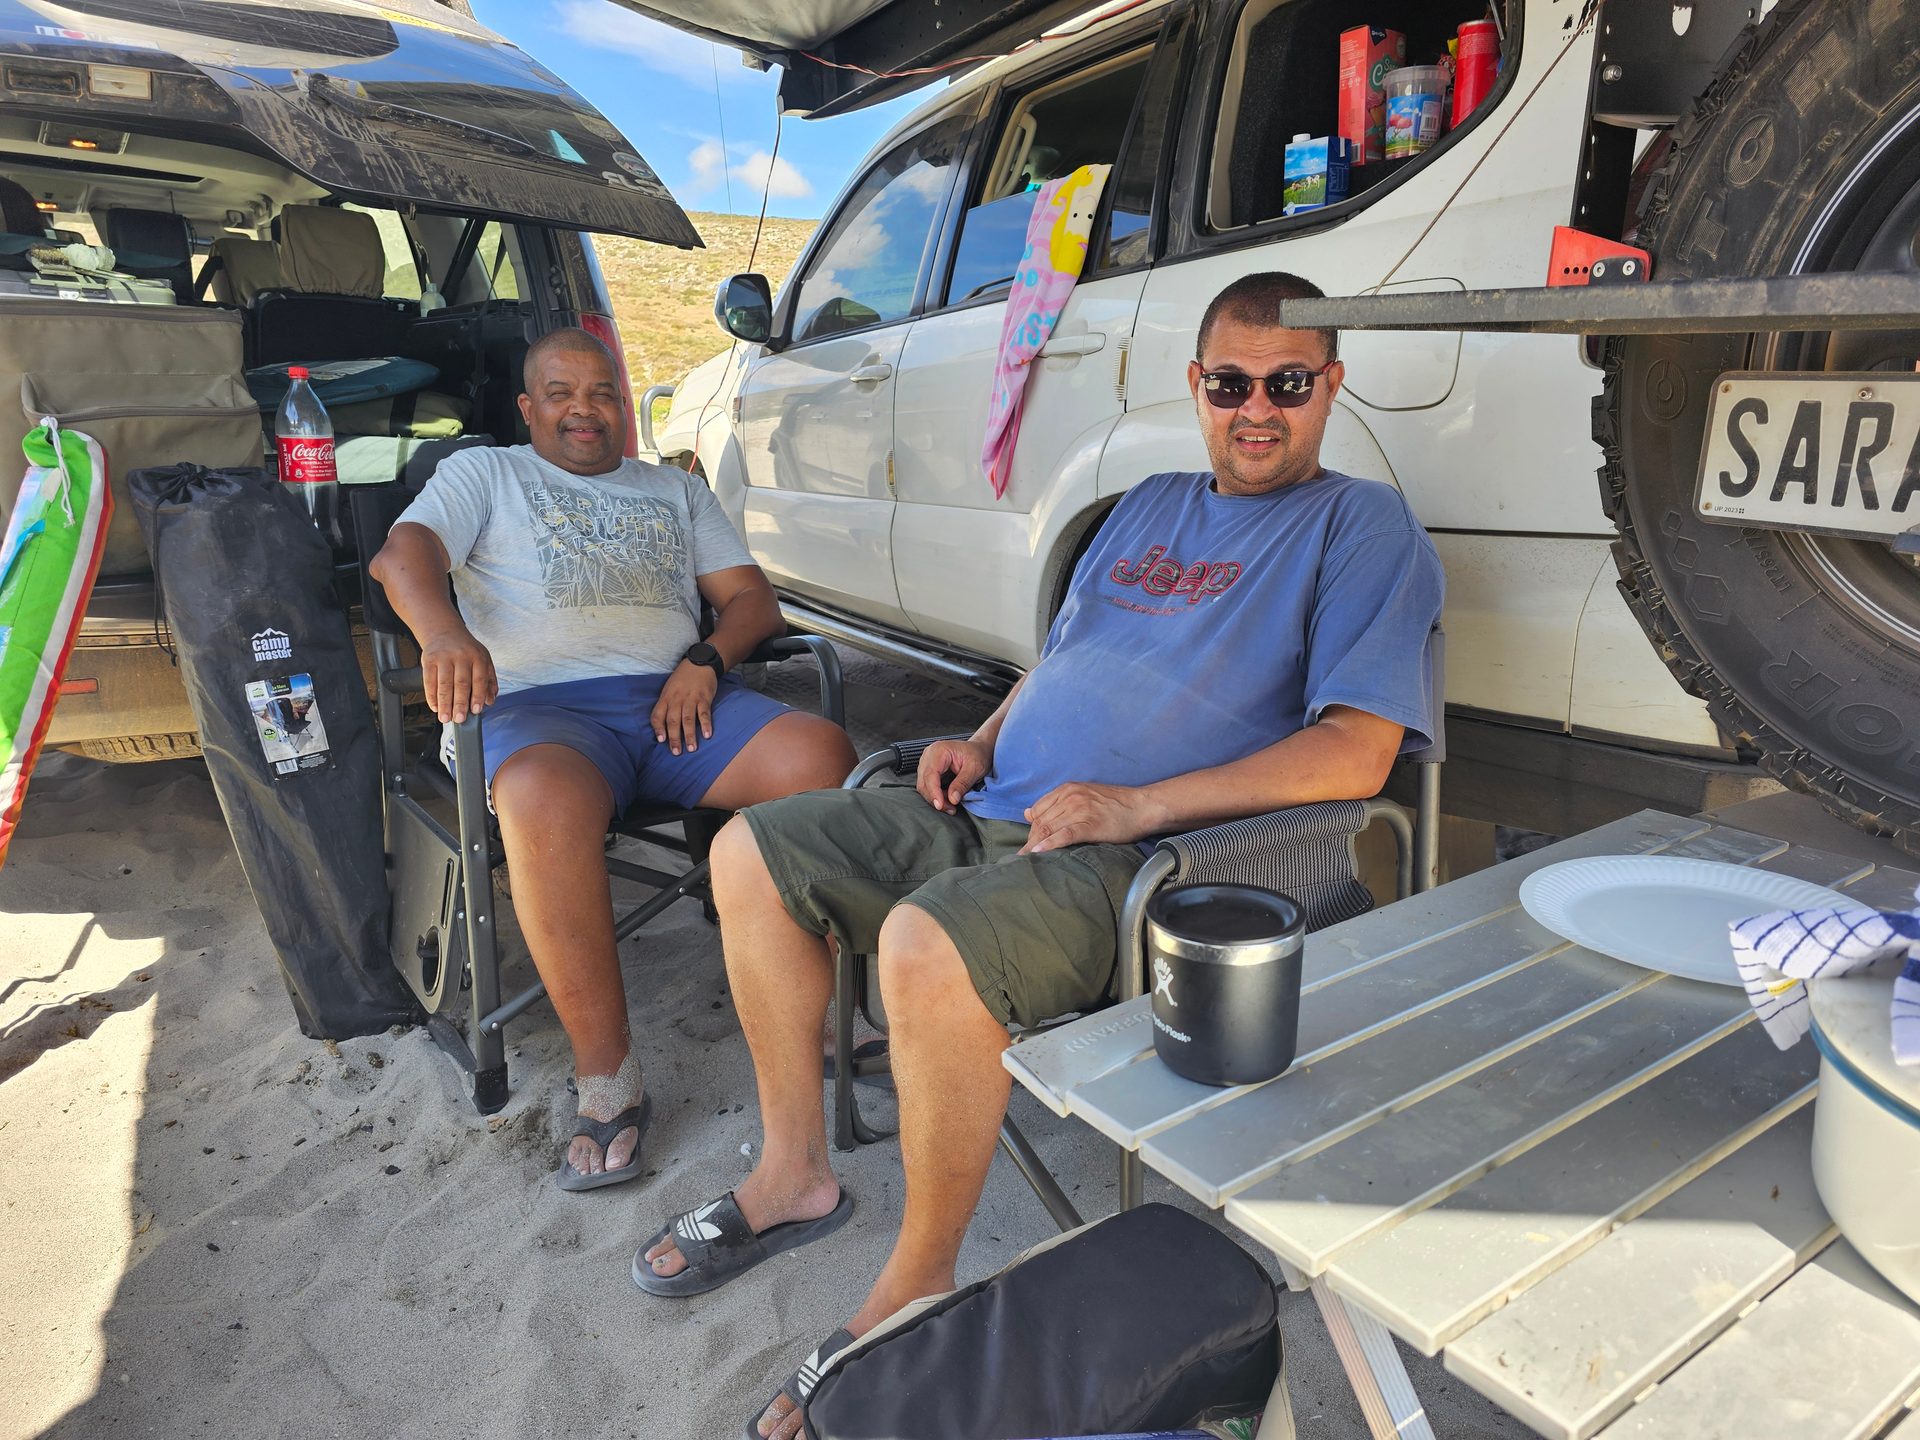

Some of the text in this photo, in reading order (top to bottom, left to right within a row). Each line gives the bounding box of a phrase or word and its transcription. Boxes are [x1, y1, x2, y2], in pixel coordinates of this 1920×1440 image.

[1111, 544, 1242, 605] Jeep
[252, 636, 290, 652] camp
[254, 648, 293, 662] master
